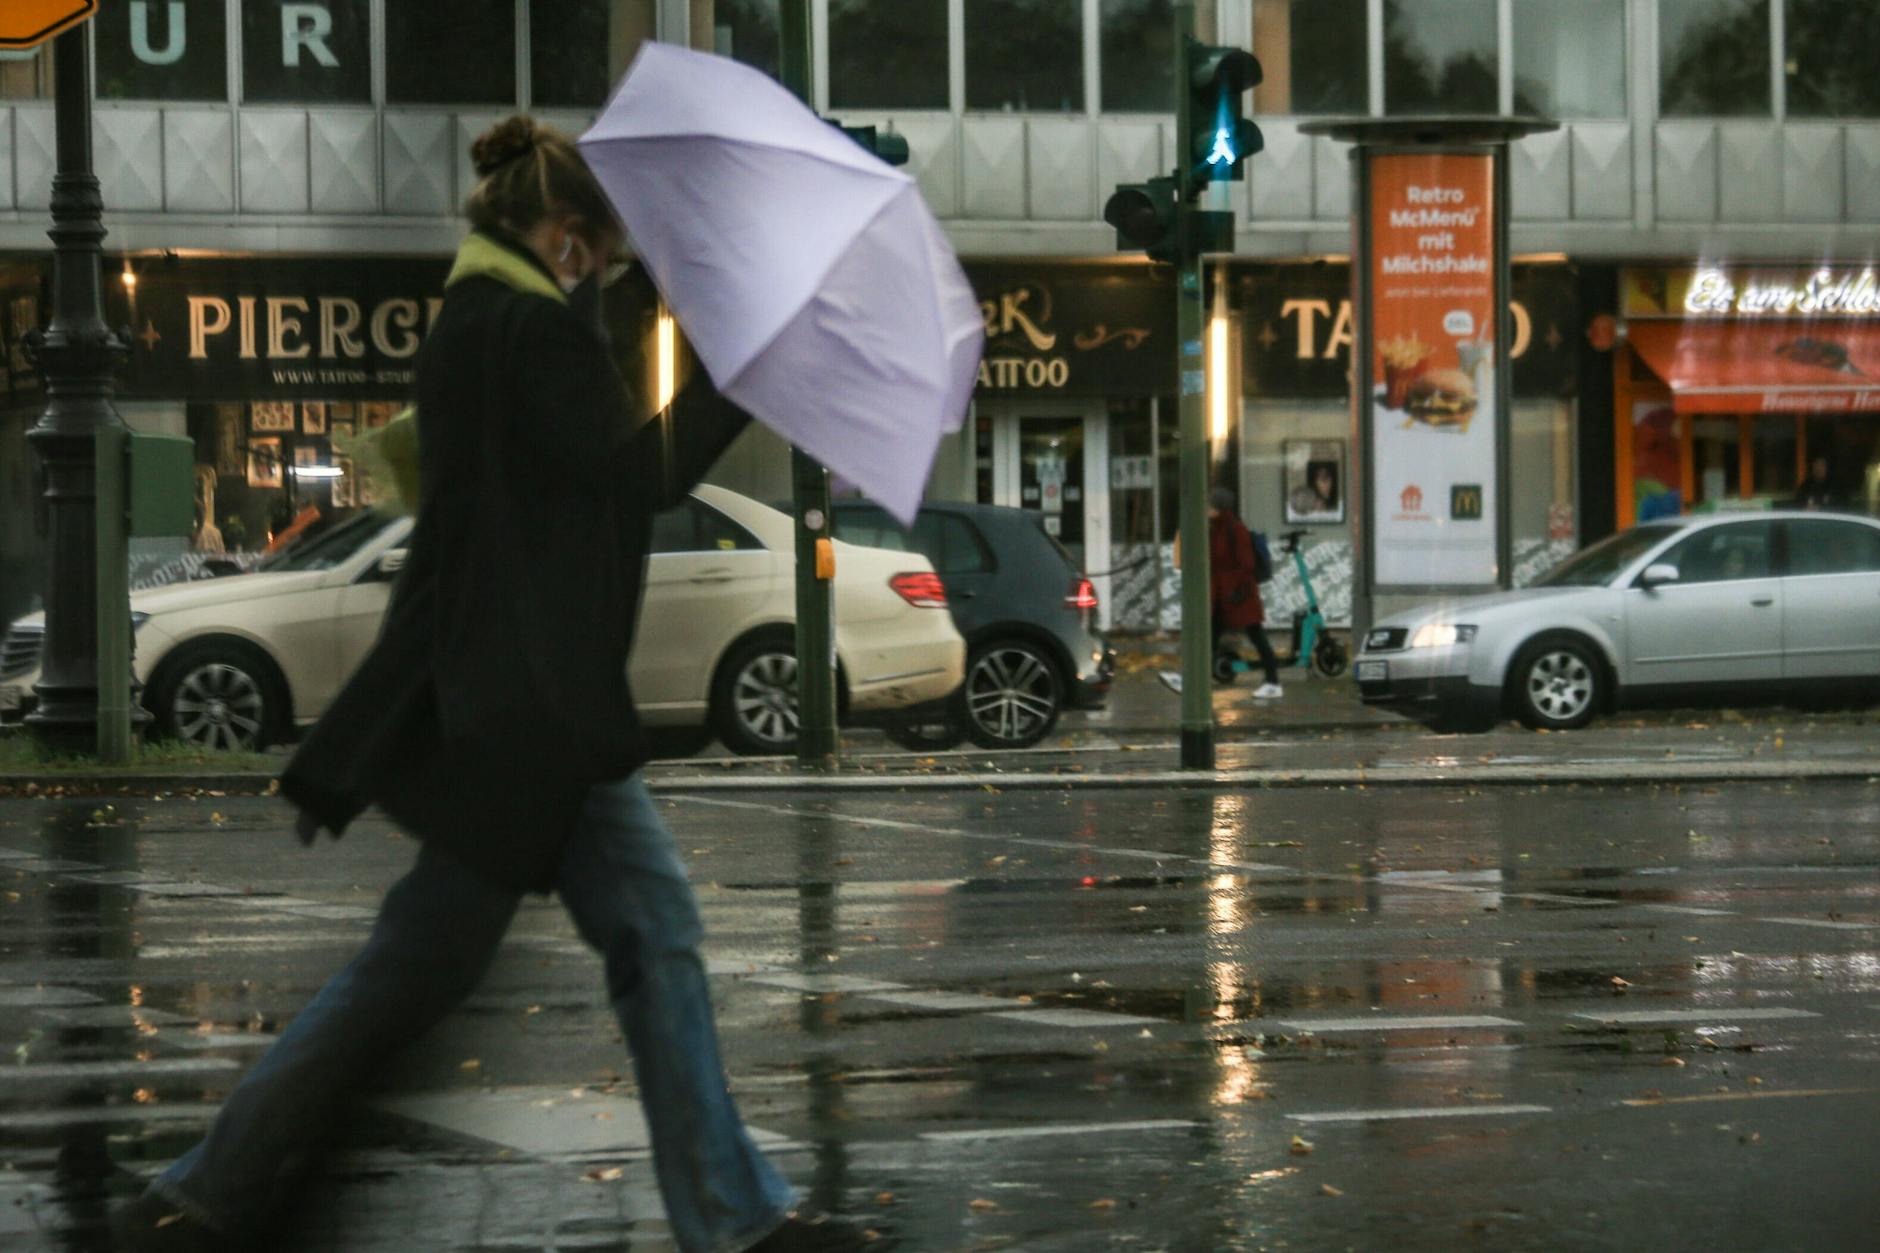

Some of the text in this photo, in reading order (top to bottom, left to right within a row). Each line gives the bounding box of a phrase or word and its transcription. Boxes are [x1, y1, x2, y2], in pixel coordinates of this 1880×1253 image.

[130, 0, 340, 67] U R
[1407, 186, 1464, 203] Retro
[1418, 231, 1455, 249] mit
[1382, 255, 1488, 273] Milchshake
